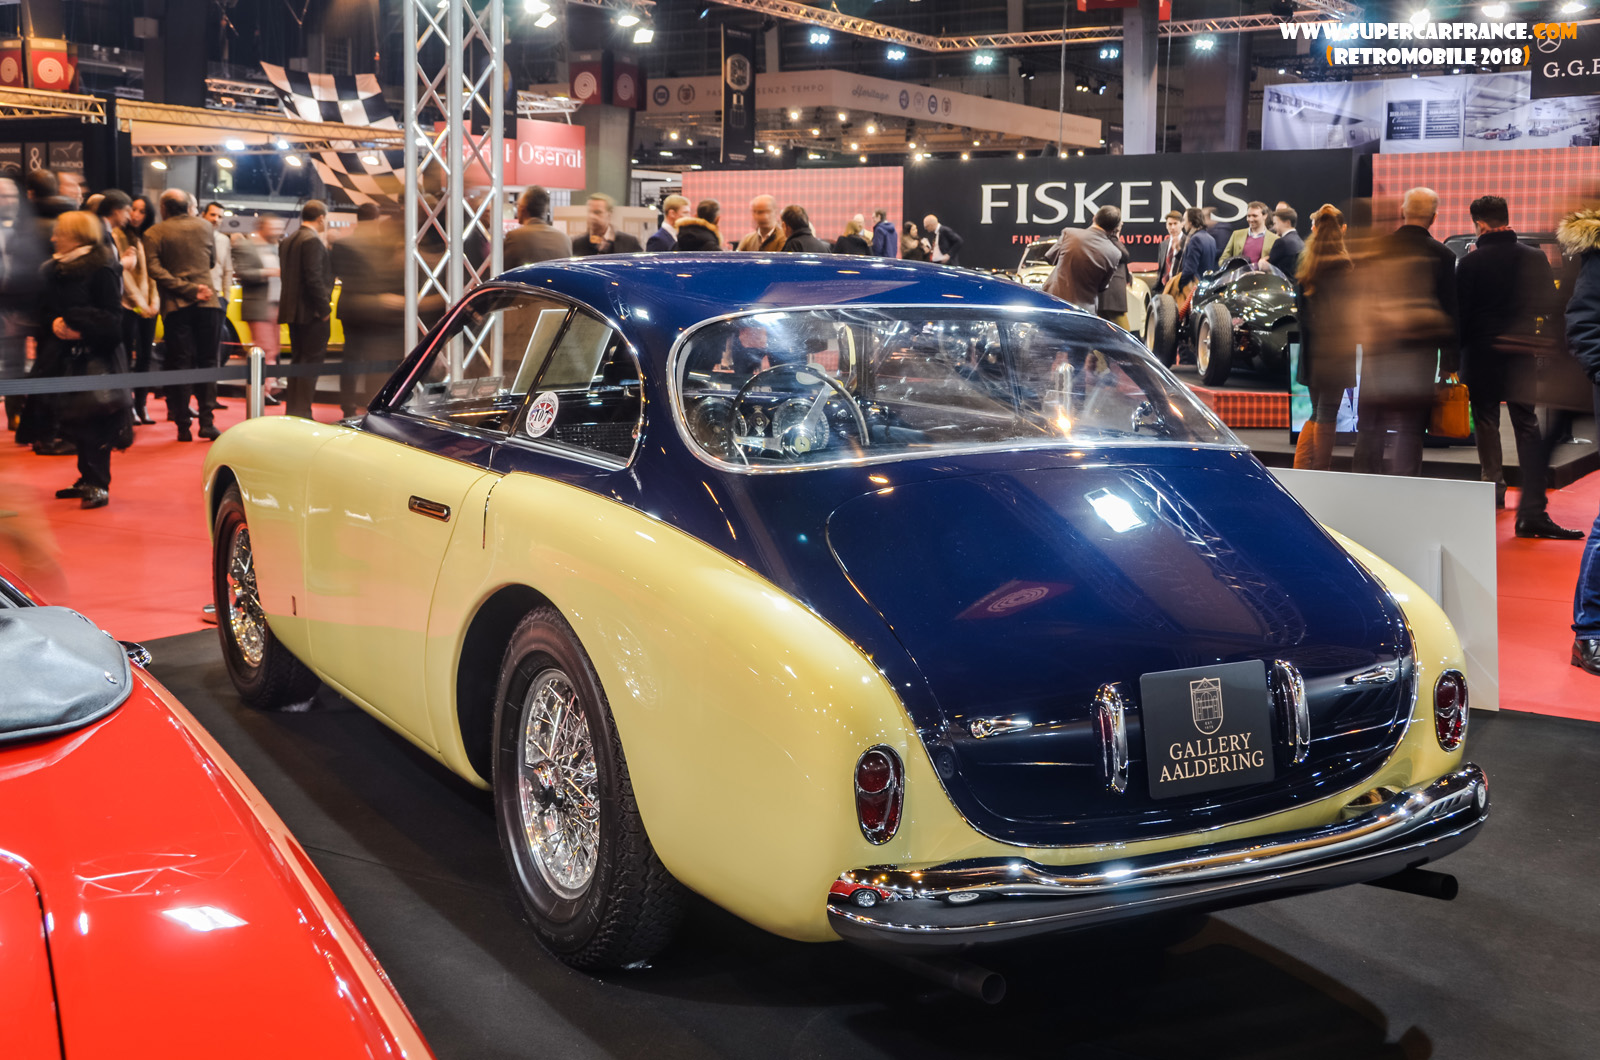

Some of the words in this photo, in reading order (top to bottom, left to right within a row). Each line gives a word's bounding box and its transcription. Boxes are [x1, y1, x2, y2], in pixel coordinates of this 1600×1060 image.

[756, 86, 787, 95] SENZA
[791, 84, 825, 93] TEMPO
[518, 141, 583, 168] Osenat
[980, 177, 1249, 224] FISKENS
[1012, 234, 1041, 244] FINE
[1169, 732, 1251, 760] GALLERY
[1159, 750, 1265, 783] AALDERING
